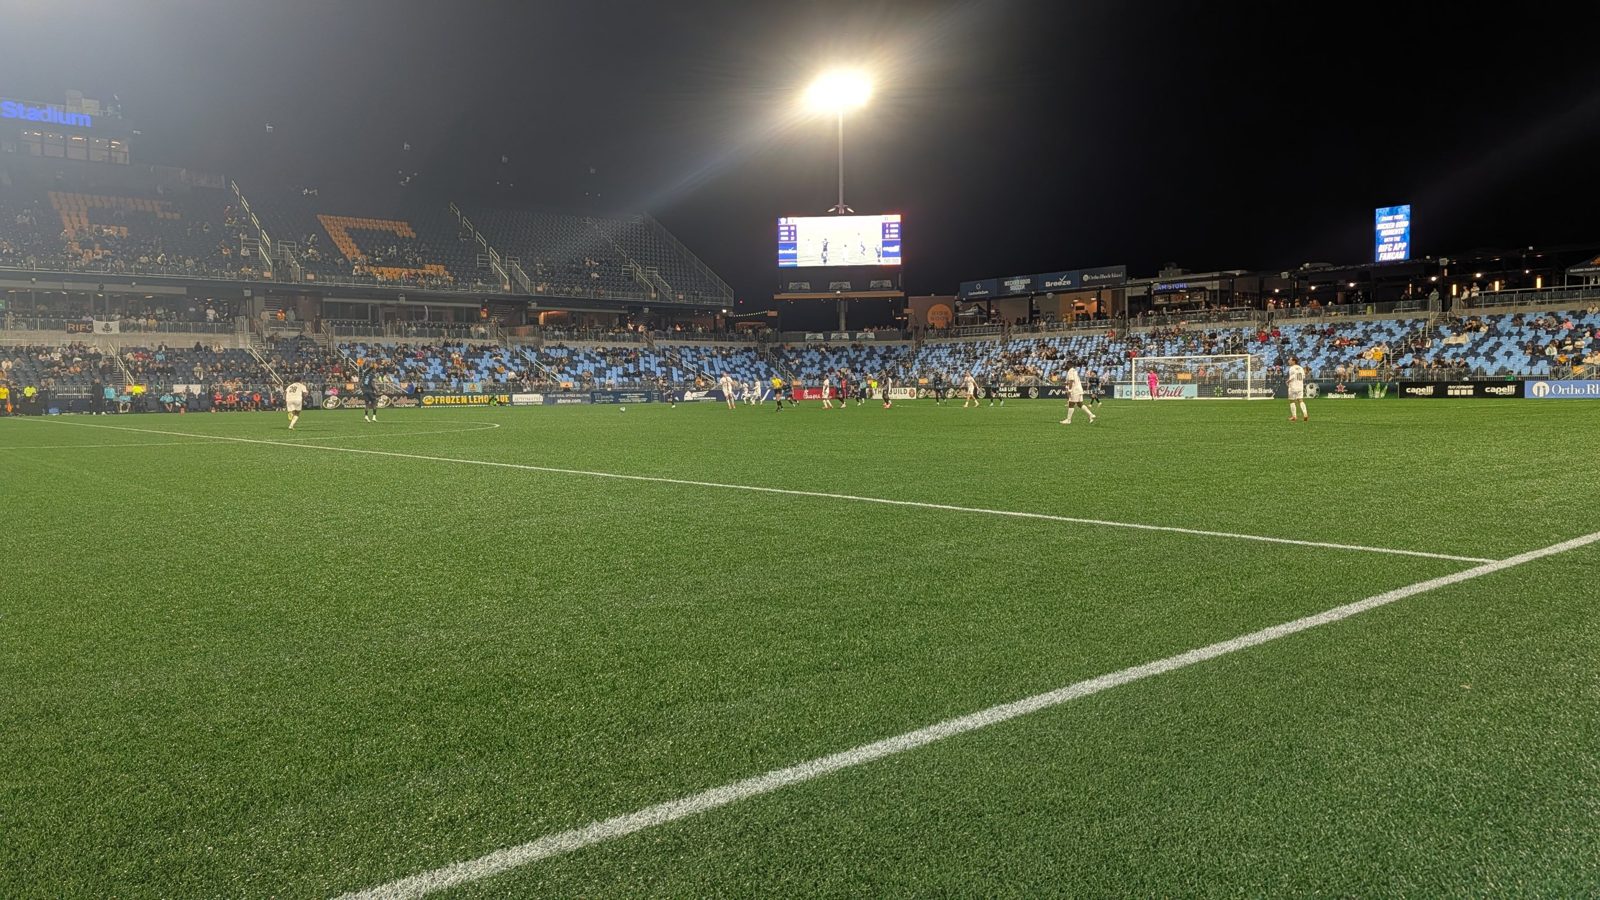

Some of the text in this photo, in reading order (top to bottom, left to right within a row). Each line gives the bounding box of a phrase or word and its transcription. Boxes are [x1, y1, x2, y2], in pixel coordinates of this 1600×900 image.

[1, 101, 91, 127] Stadium
[289, 386, 298, 394] 28
[1156, 386, 1184, 398] Chill
[1406, 386, 1434, 395] capelli
[1485, 385, 1516, 395] capelli
[1551, 385, 1585, 395] Ortho
[435, 395, 468, 405] FROZEN
[468, 394, 510, 404] LEMOADE
